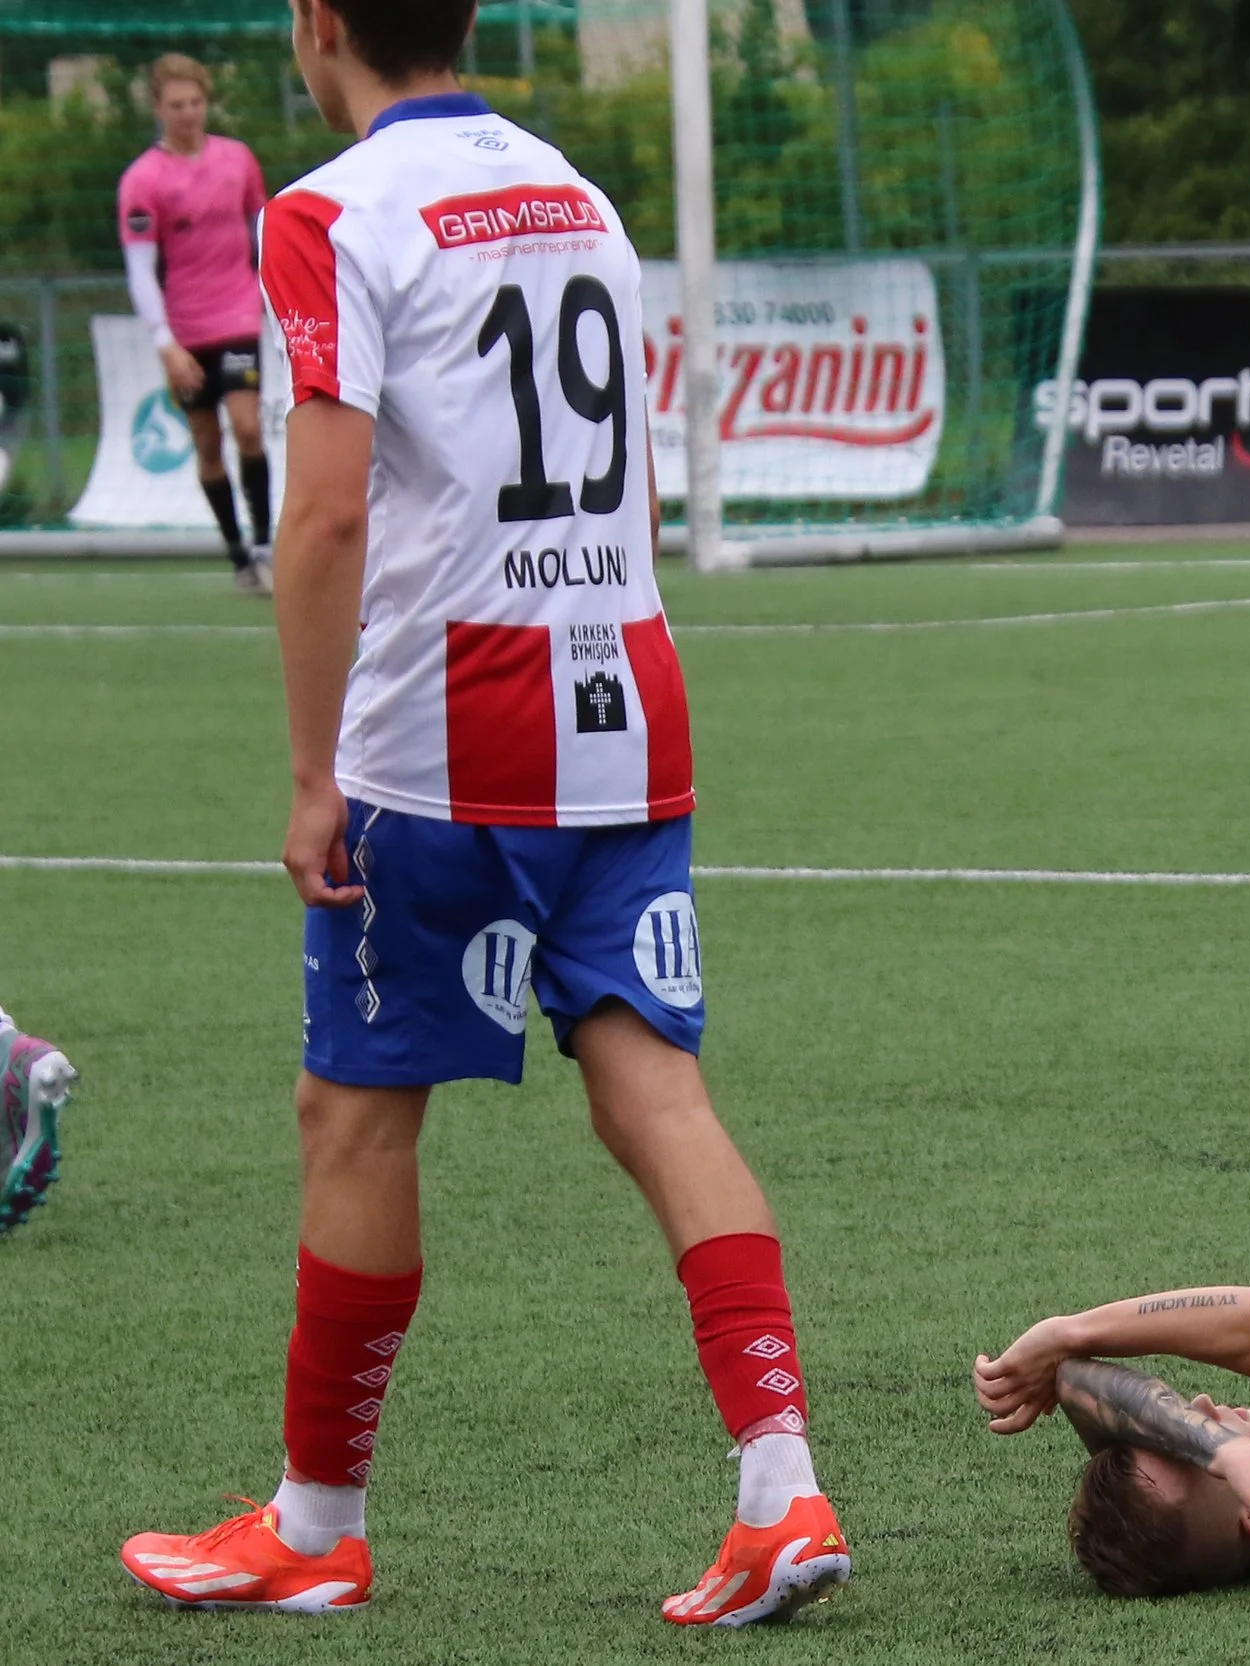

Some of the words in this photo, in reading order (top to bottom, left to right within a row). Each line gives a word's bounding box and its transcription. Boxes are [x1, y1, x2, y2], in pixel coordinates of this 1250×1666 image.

[438, 199, 601, 242] GRIMSRUD
[477, 273, 628, 523] 19
[644, 313, 934, 441] izanini
[1102, 435, 1224, 477] Revetal
[569, 623, 616, 642] KIRKENS
[571, 642, 620, 665] BYMISJON
